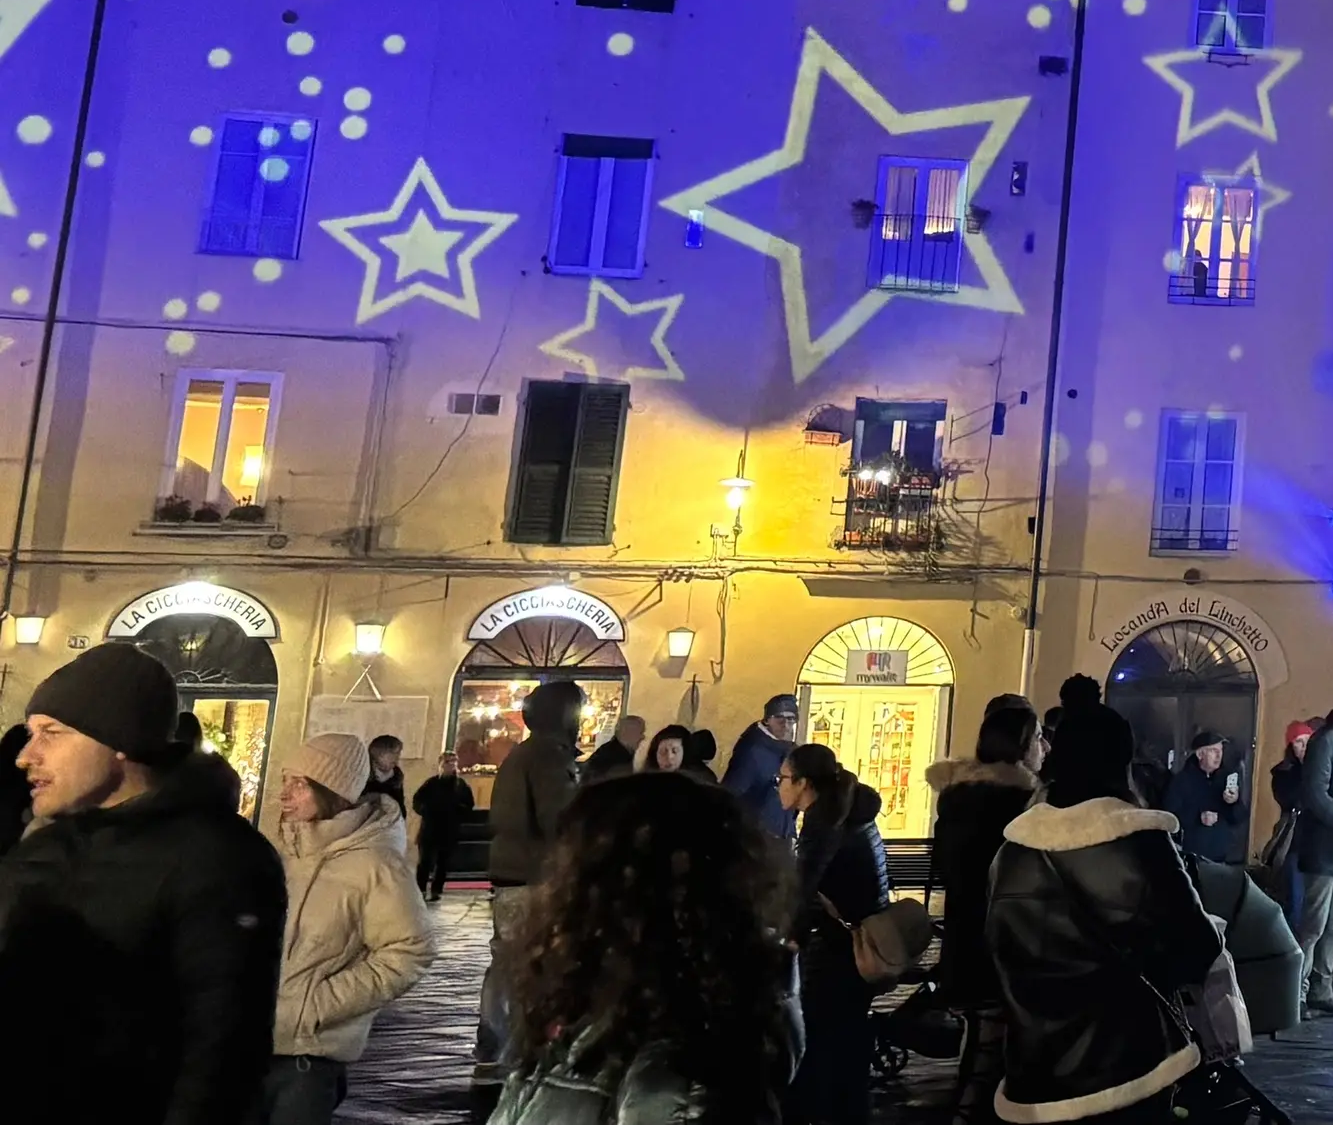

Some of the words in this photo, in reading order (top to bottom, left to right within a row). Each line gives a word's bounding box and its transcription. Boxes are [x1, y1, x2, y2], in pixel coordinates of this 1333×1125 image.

[1179, 597, 1200, 614] del
[121, 610, 145, 630] LA
[480, 613, 503, 633] LA
